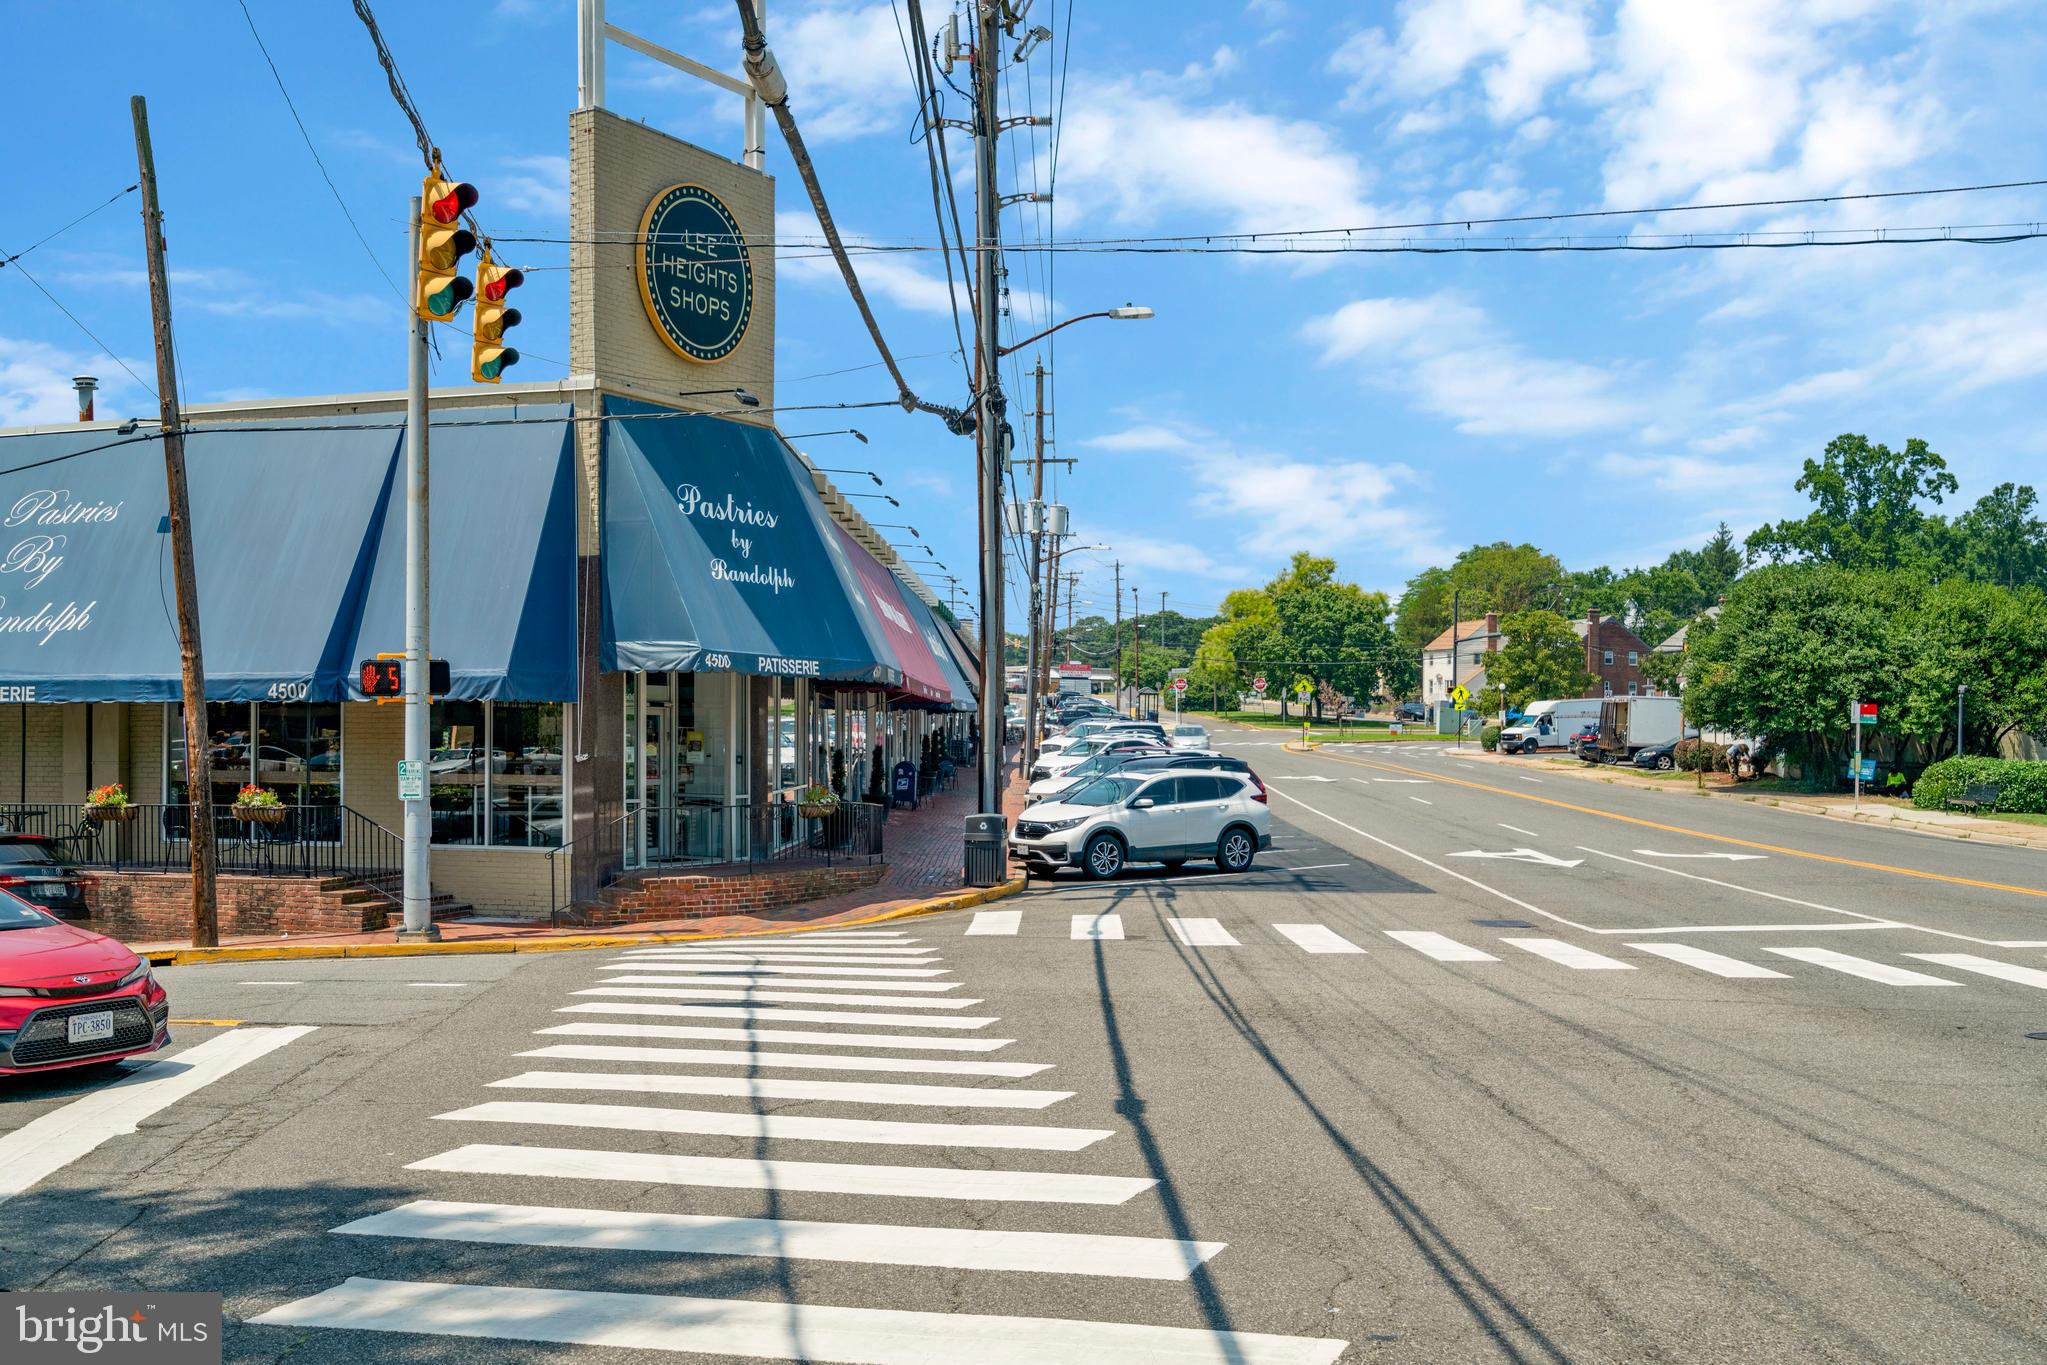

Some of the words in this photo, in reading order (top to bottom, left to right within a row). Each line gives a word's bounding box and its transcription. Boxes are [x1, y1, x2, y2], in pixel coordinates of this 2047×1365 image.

[685, 228, 718, 258] LEE
[662, 252, 738, 294] HEIGHTS
[670, 286, 731, 321] SHOPS
[4, 489, 124, 527] Pastries
[677, 483, 779, 529] Pastries
[731, 529, 753, 559] by
[0, 534, 67, 590] By
[710, 558, 796, 595] Randolph
[388, 666, 399, 690] 5
[704, 653, 732, 669] 4500
[758, 657, 821, 675] PATISSERIE
[268, 682, 308, 699] 4500
[72, 1018, 111, 1035] TPC-3850
